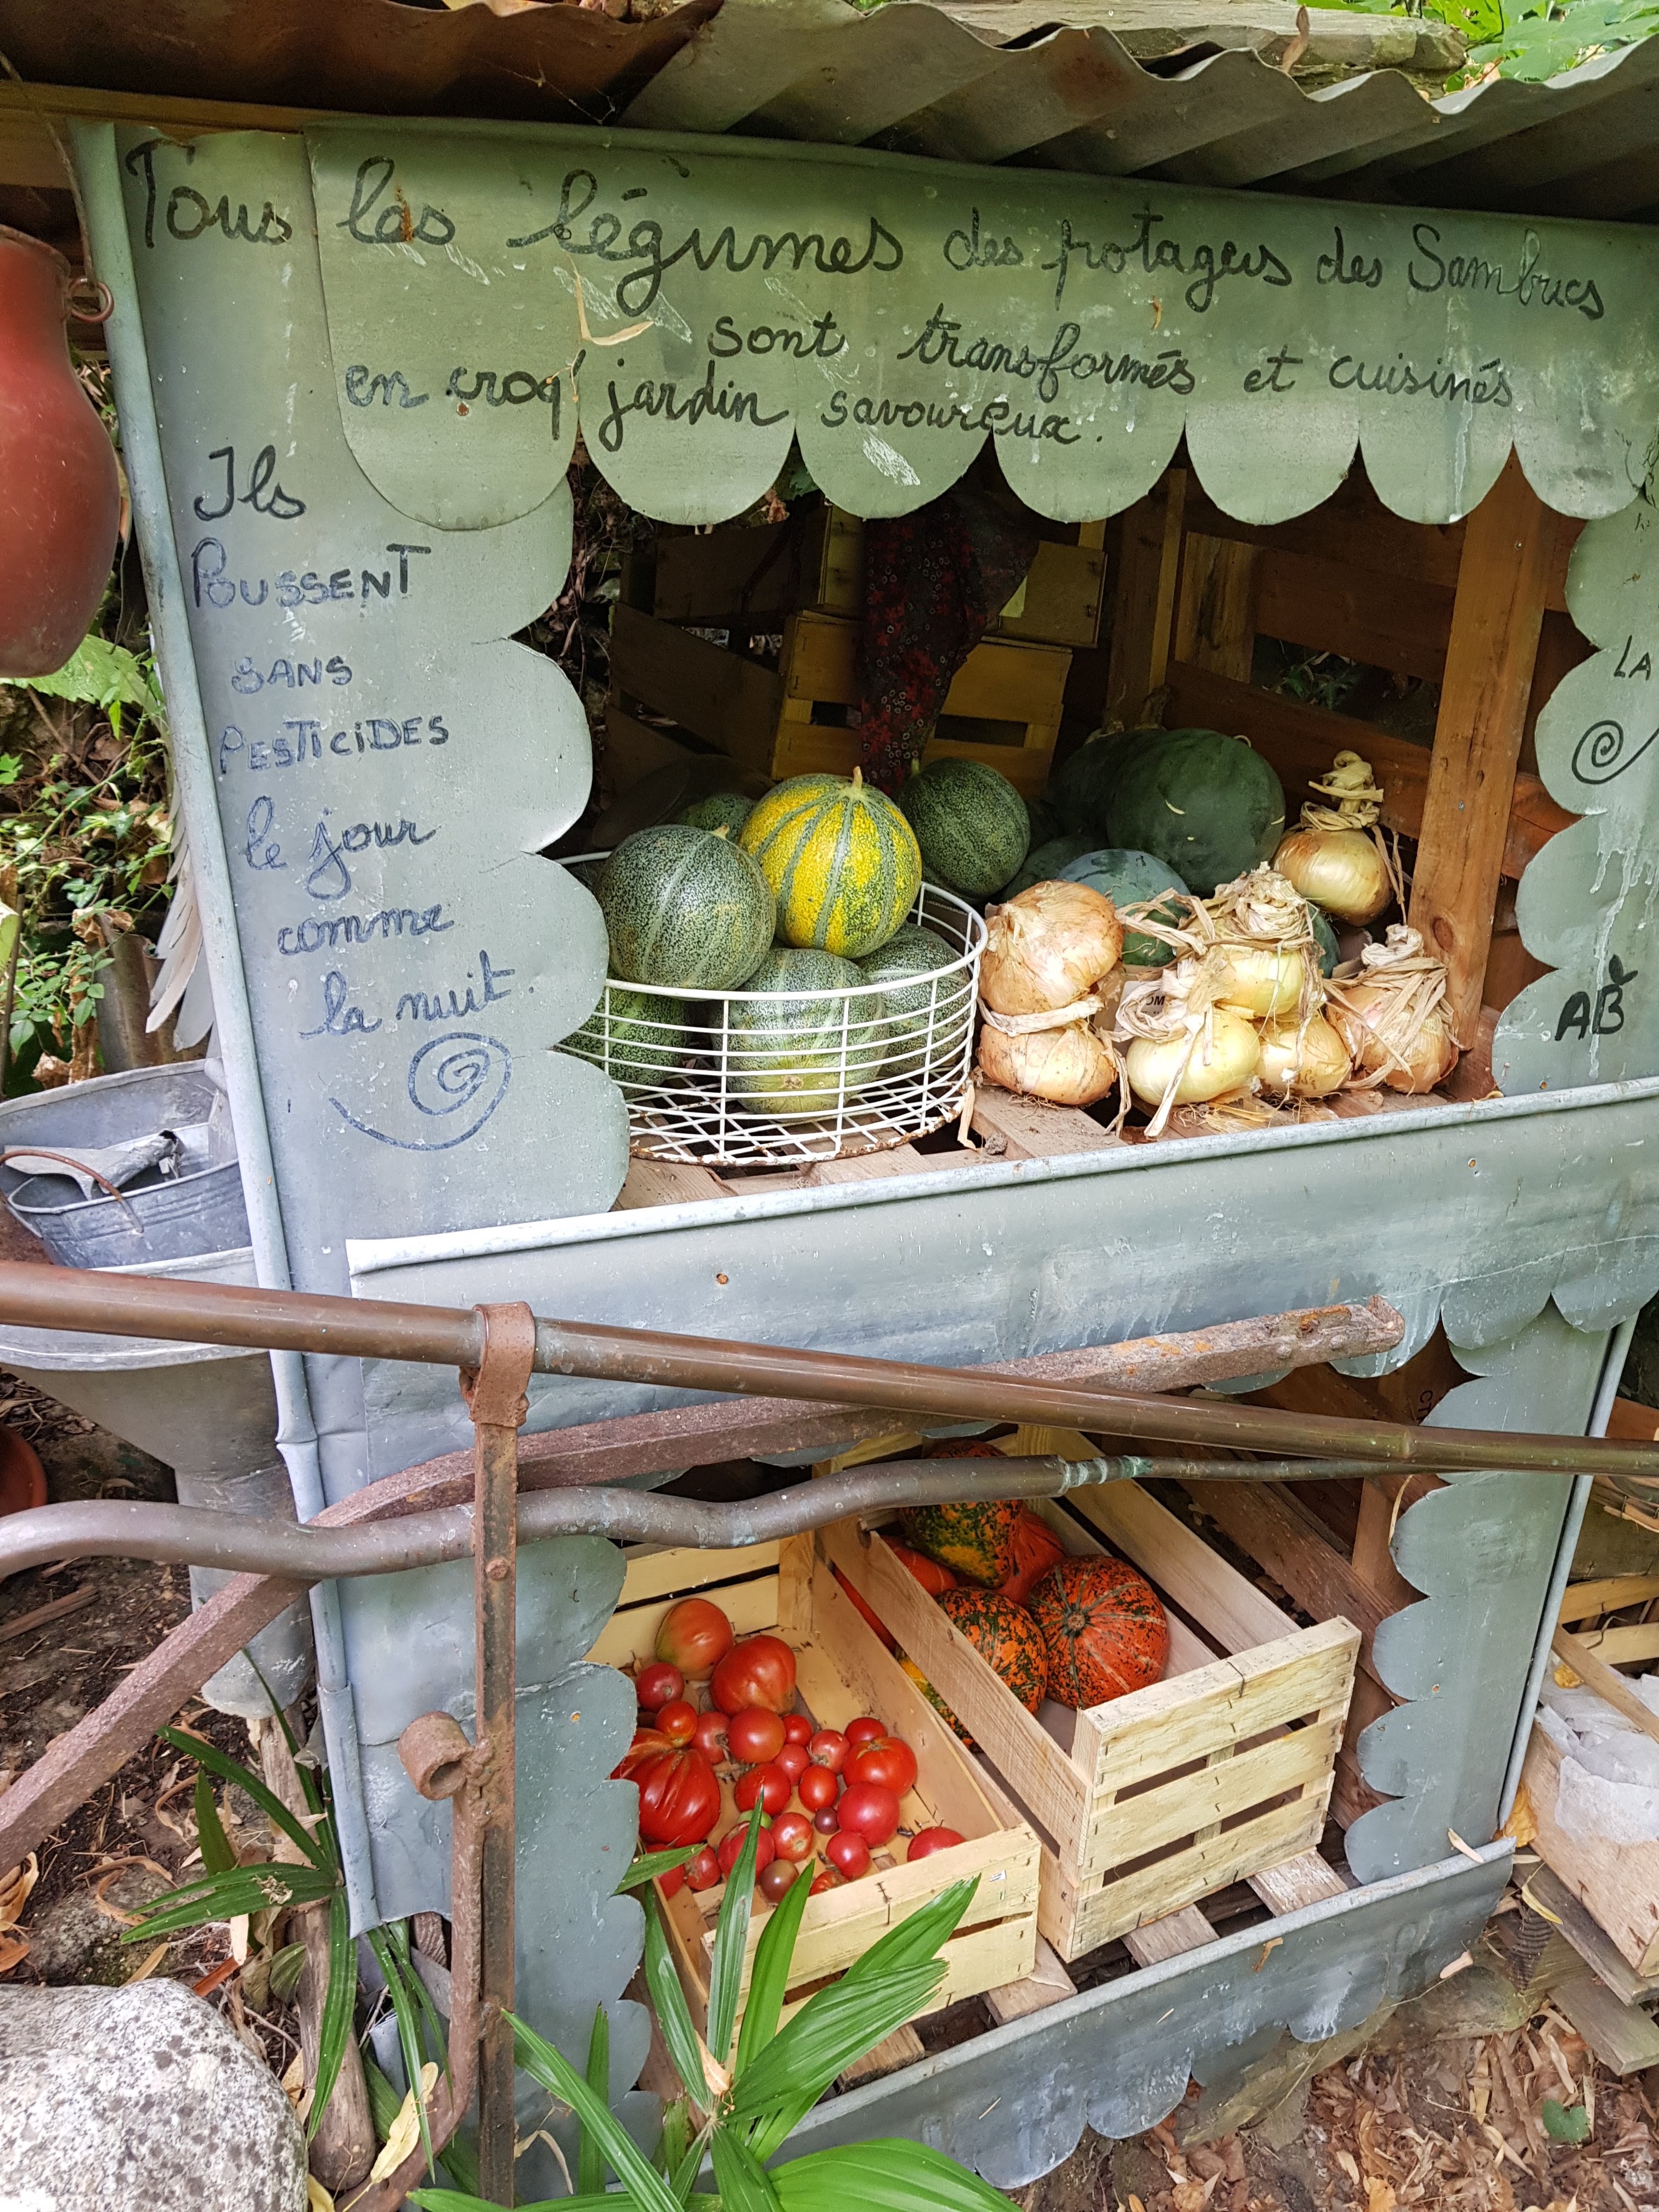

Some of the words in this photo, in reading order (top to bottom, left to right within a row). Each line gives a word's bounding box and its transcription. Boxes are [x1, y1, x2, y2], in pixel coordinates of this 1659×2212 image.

[126, 138, 292, 249] Tous
[336, 156, 455, 245] les
[506, 169, 904, 317] légumes
[943, 207, 1024, 270] des
[1317, 226, 1383, 287] des
[708, 311, 847, 358] sont
[897, 302, 1195, 403] transformés
[1243, 344, 1303, 392] et
[1329, 352, 1513, 407] cuisinés
[346, 365, 430, 408] en
[599, 359, 789, 452] jardin
[231, 656, 353, 693] SANS
[1613, 635, 1651, 681] LA
[247, 795, 287, 870] le
[306, 808, 441, 900] jour
[278, 904, 454, 956] comme
[299, 971, 382, 1036] la
